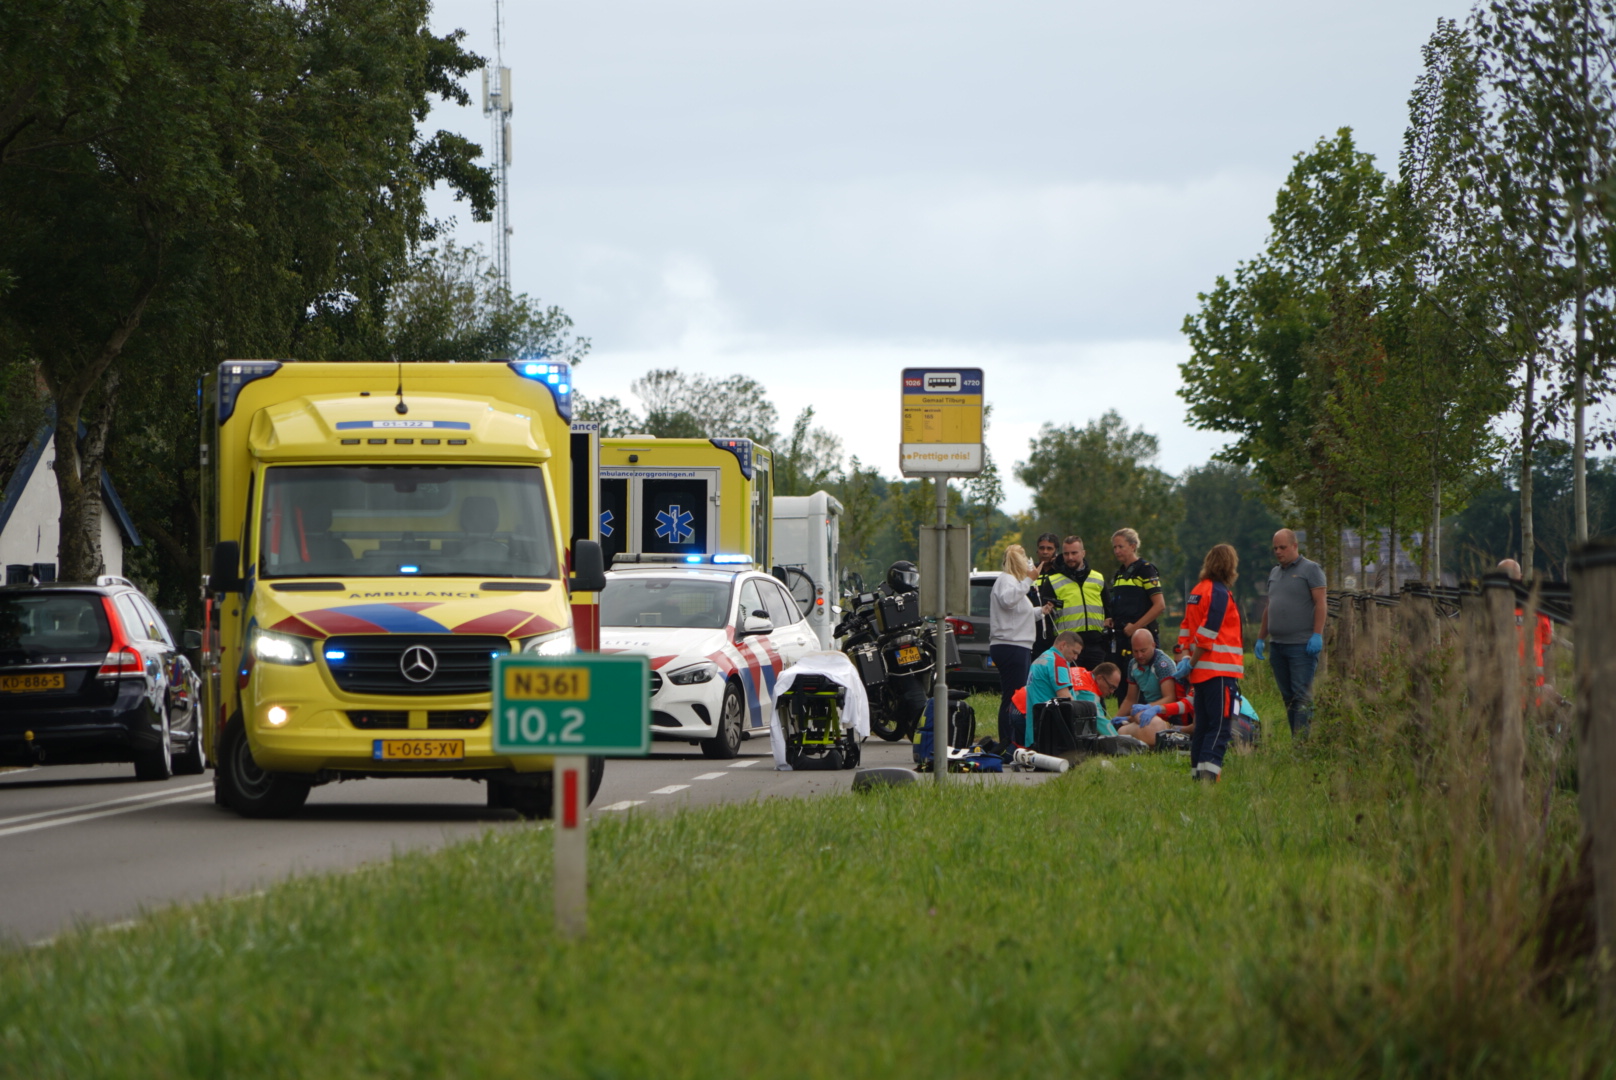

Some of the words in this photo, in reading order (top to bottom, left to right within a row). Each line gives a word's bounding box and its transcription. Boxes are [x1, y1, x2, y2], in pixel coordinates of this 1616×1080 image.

[913, 452, 949, 462] Prettige
[950, 452, 970, 460] reis!
[348, 591, 480, 599] AMBULANCE
[2, 676, 61, 689] KD-886-S
[513, 672, 579, 695] N361
[505, 706, 586, 743] 10.2
[387, 742, 459, 756] L-065-XV
